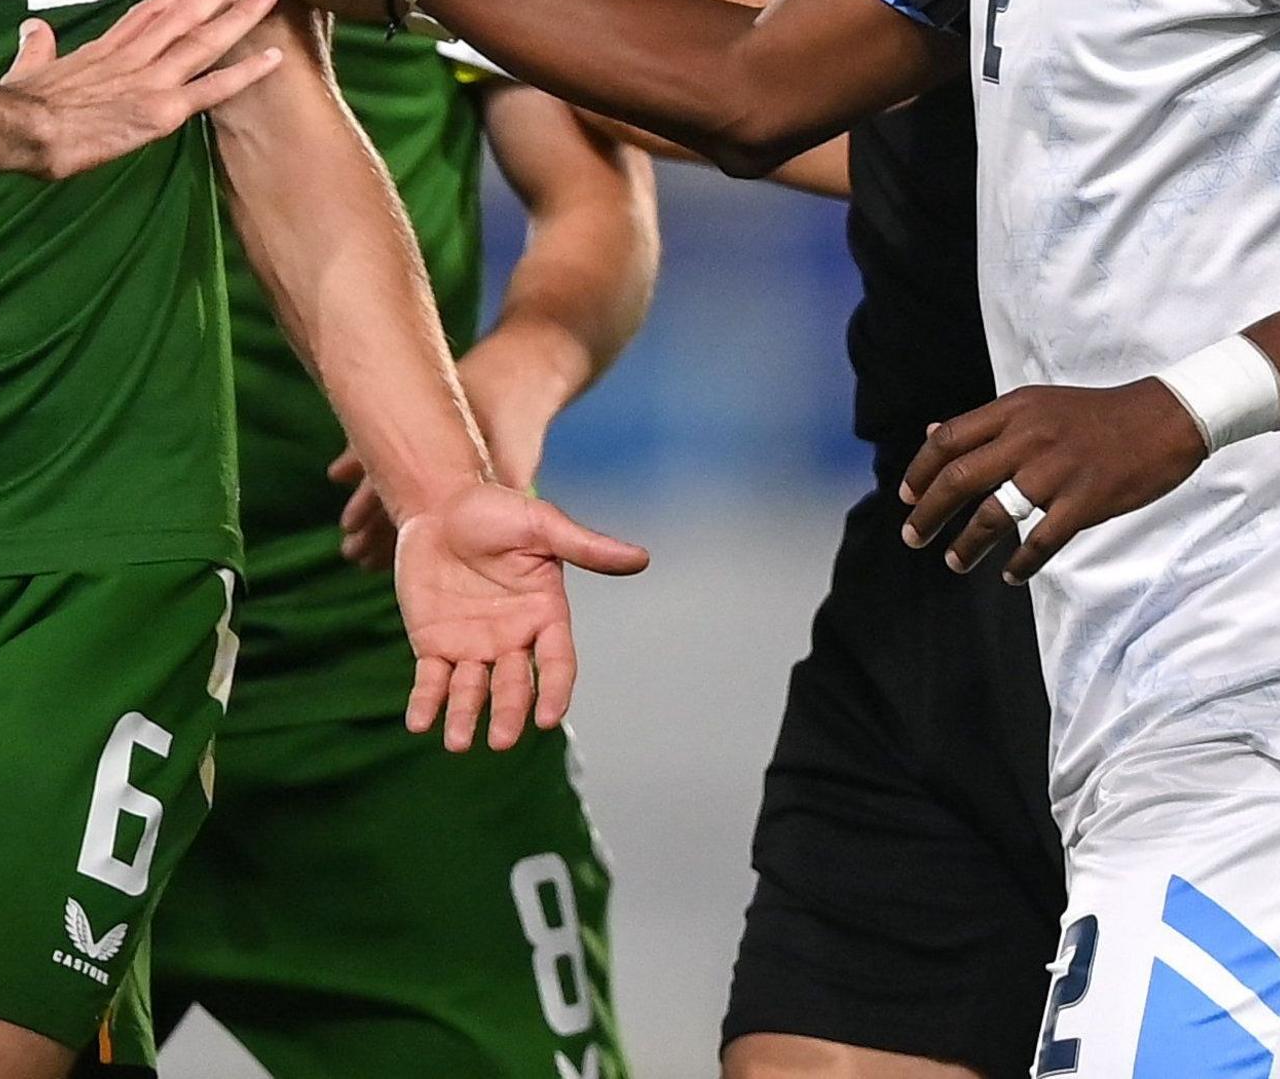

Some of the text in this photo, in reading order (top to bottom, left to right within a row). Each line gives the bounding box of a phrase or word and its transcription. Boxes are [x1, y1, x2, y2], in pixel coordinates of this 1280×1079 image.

[76, 711, 173, 896] 6
[52, 949, 109, 986] CASTORE
[509, 852, 593, 1036] 8
[1036, 914, 1099, 1078] 2
